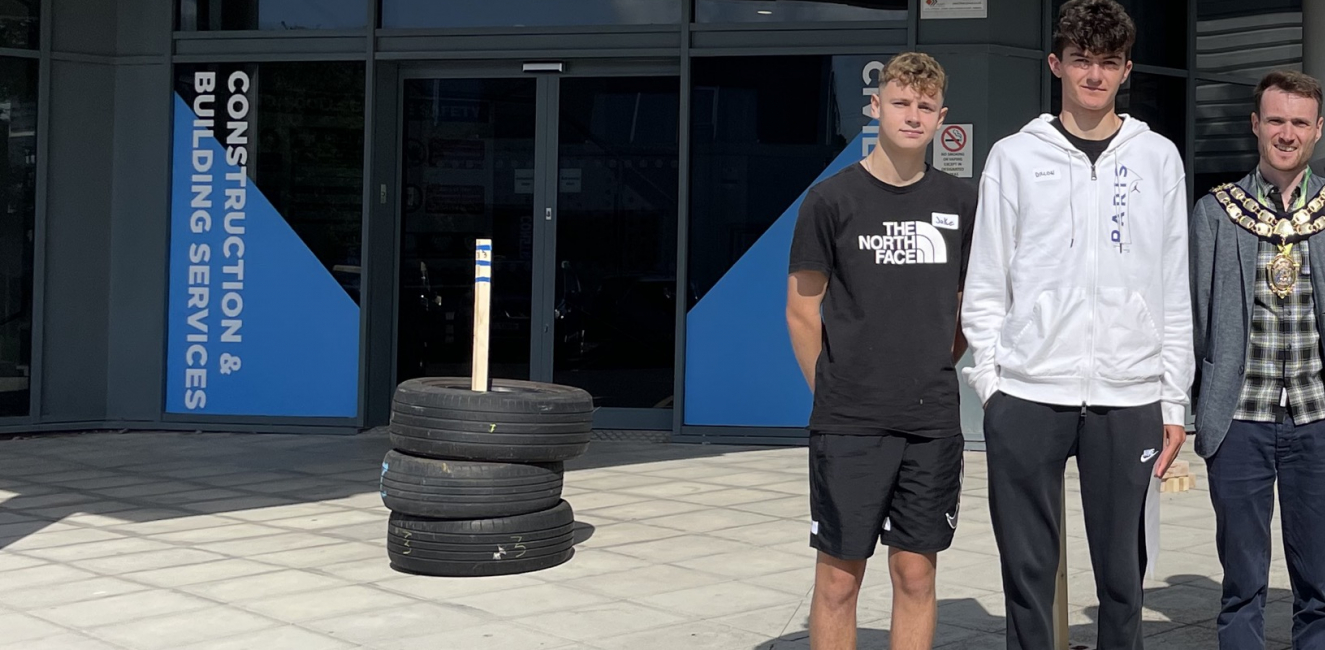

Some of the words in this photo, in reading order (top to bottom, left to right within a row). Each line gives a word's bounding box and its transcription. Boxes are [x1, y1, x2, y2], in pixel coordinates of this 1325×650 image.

[189, 71, 216, 234] BUILDING
[220, 70, 250, 343] CONSTRUCTION
[882, 221, 916, 236] THE
[858, 234, 916, 250] NORTH
[875, 249, 917, 265] FACE
[184, 242, 211, 410] SERVICES
[219, 352, 242, 375] &
